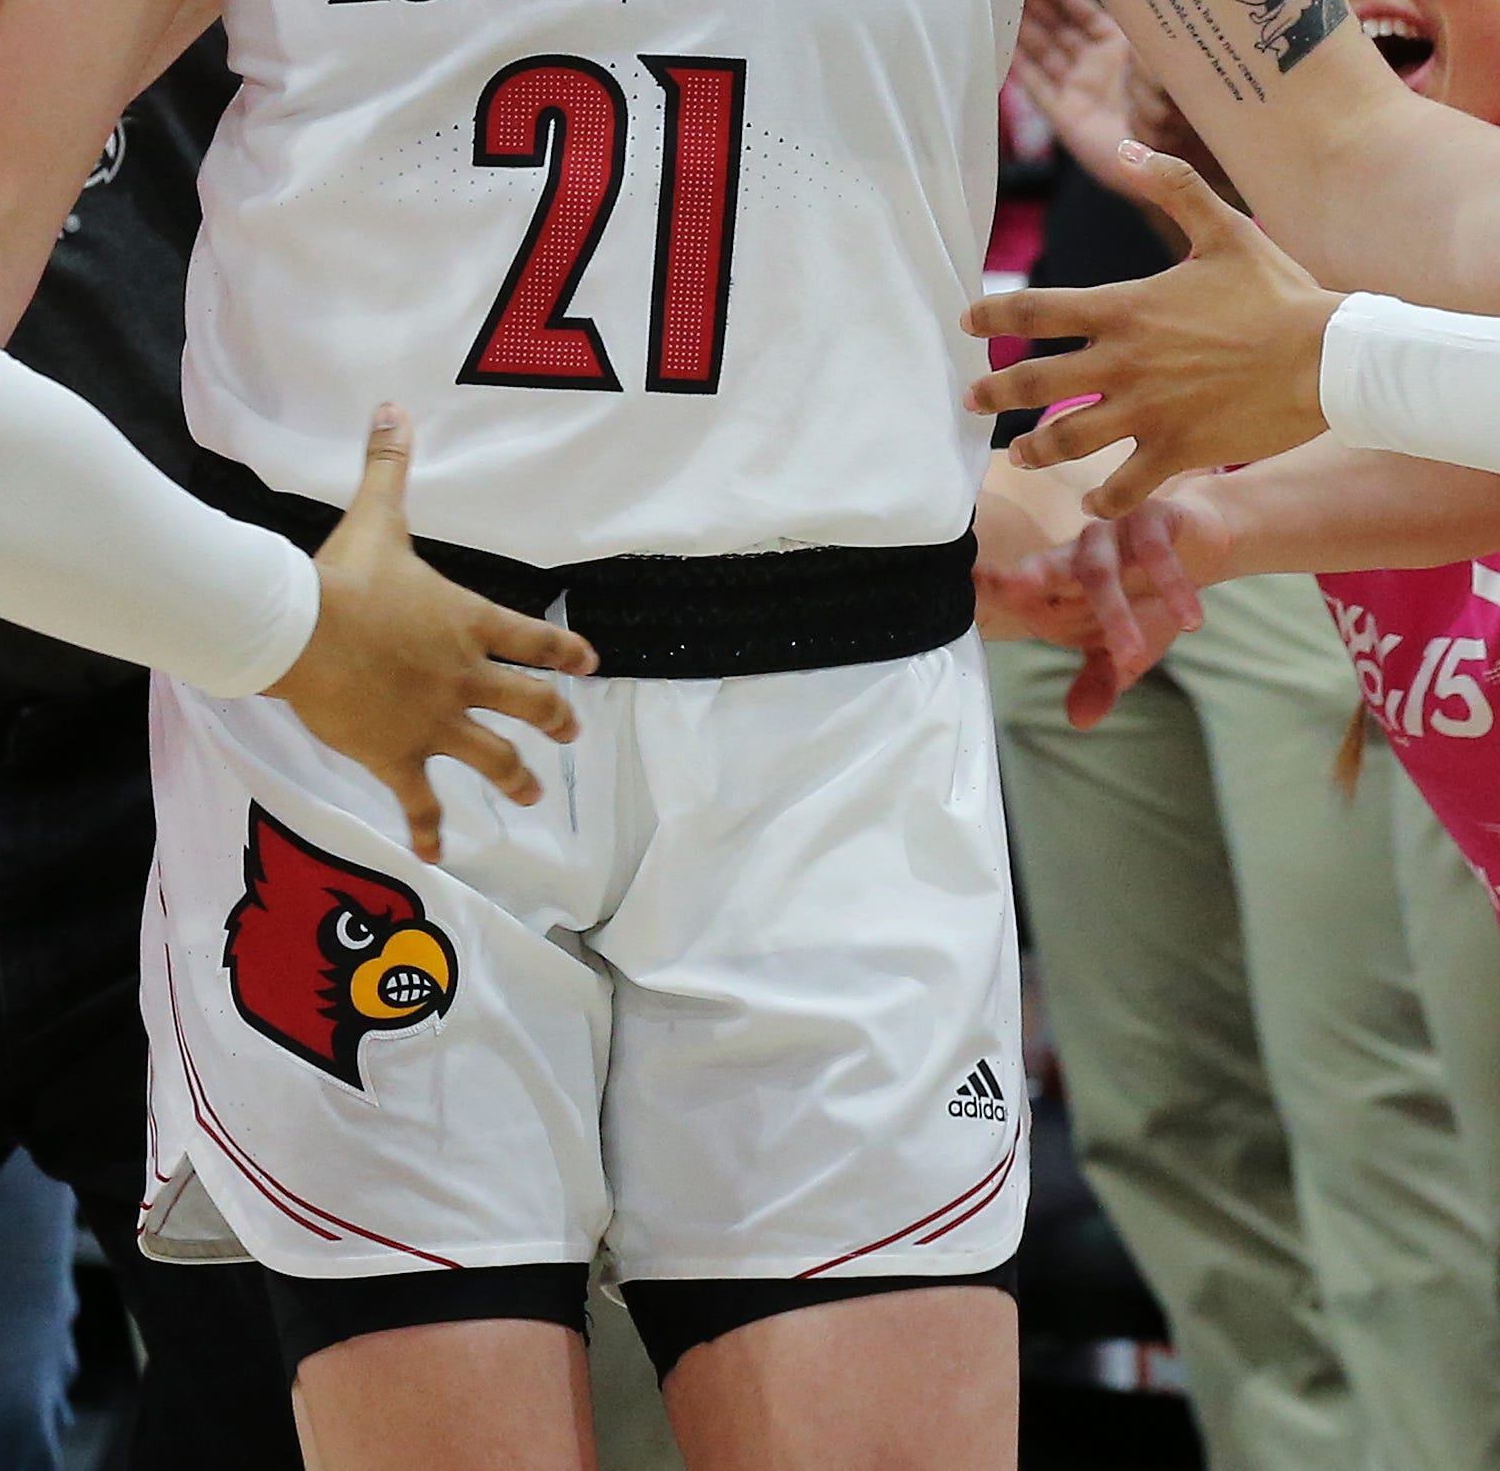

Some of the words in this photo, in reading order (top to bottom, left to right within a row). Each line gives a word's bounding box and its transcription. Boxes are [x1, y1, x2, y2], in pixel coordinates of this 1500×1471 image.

[456, 53, 747, 395] 21
[1402, 636, 1494, 739] 15
[948, 1096, 1009, 1122] adida
